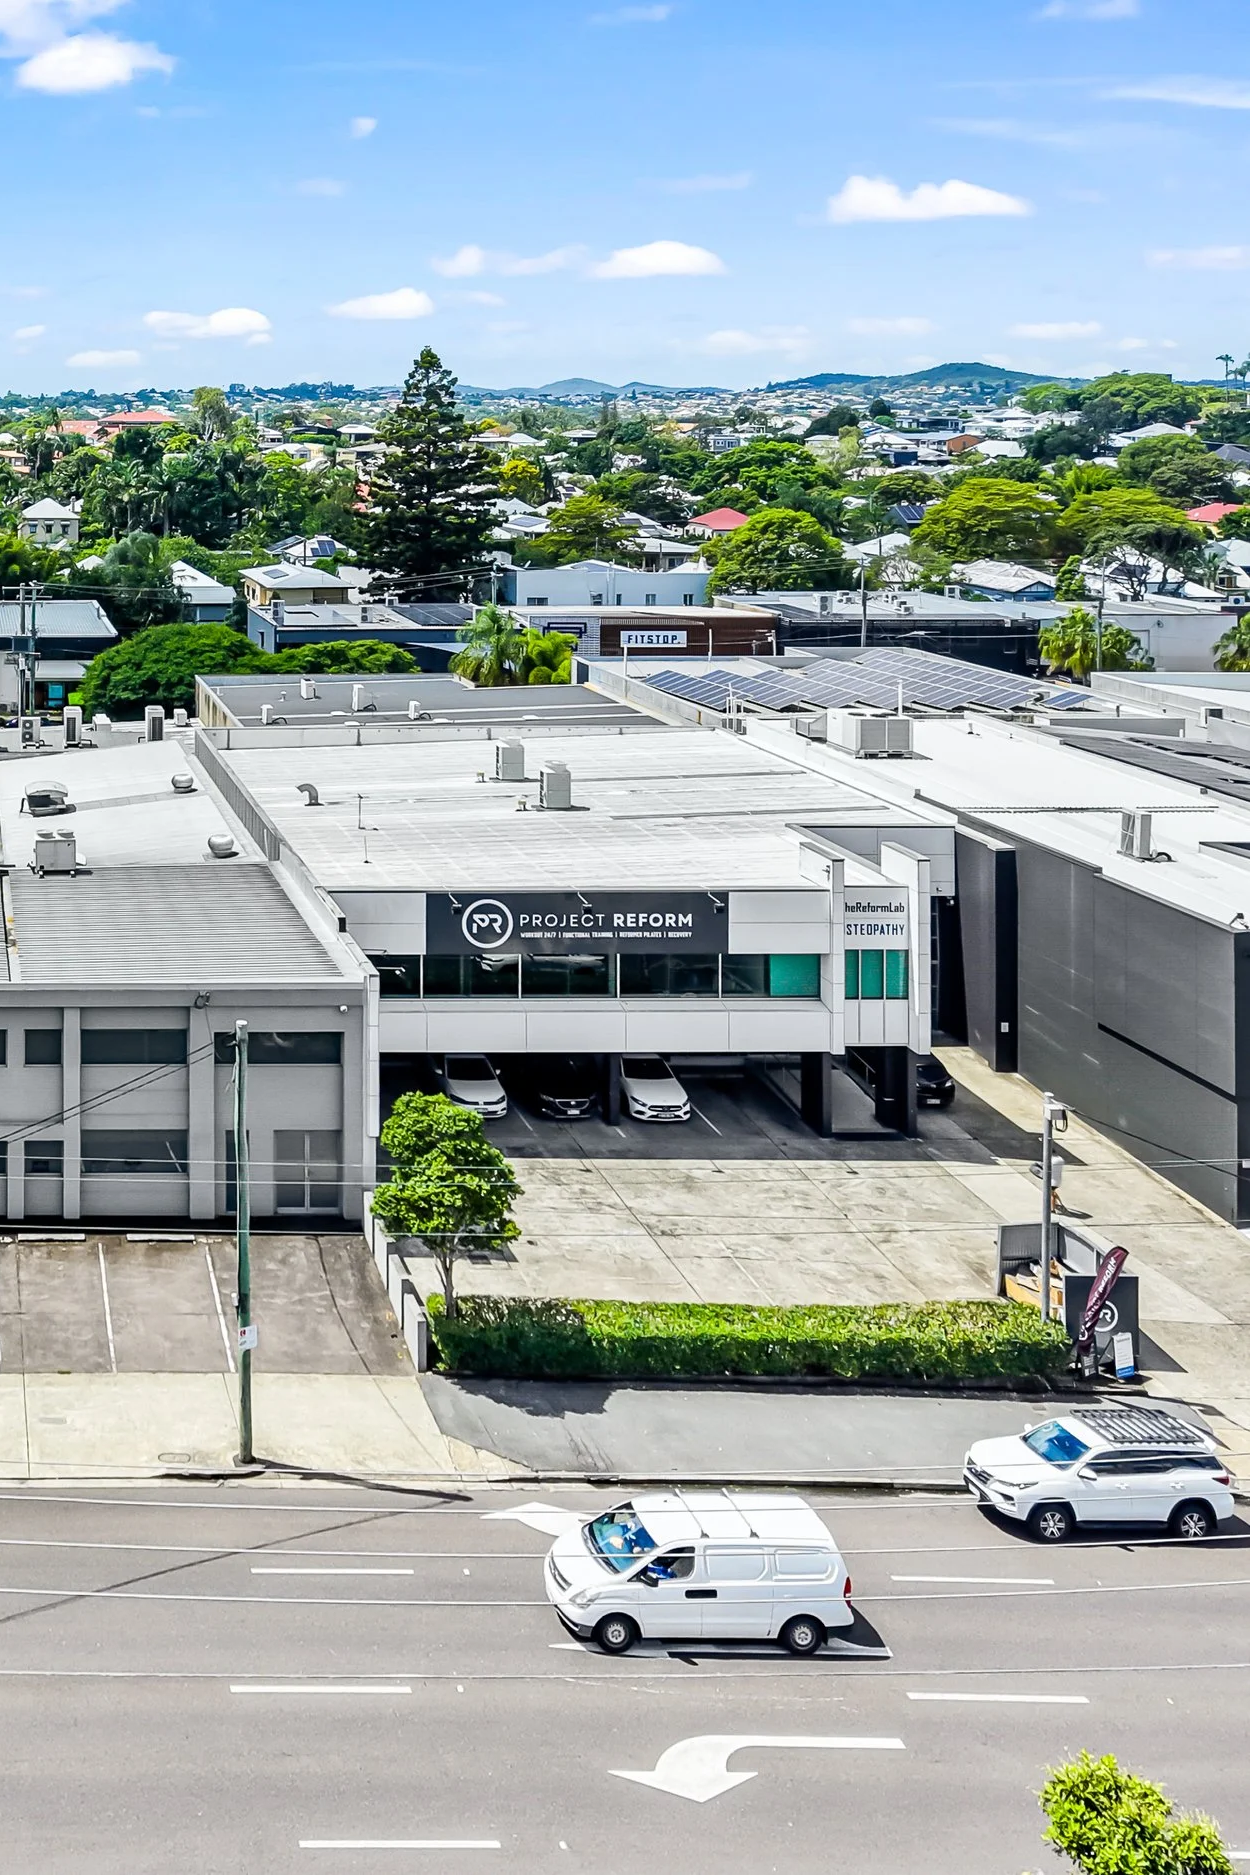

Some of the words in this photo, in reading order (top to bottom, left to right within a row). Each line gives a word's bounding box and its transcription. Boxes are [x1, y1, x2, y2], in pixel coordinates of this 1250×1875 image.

[627, 634, 681, 645] FITSTOP.
[845, 902, 905, 913] heReformLab
[519, 914, 605, 927] PROJECT
[613, 913, 693, 927] REFORM
[846, 924, 905, 935] STEOPATHY
